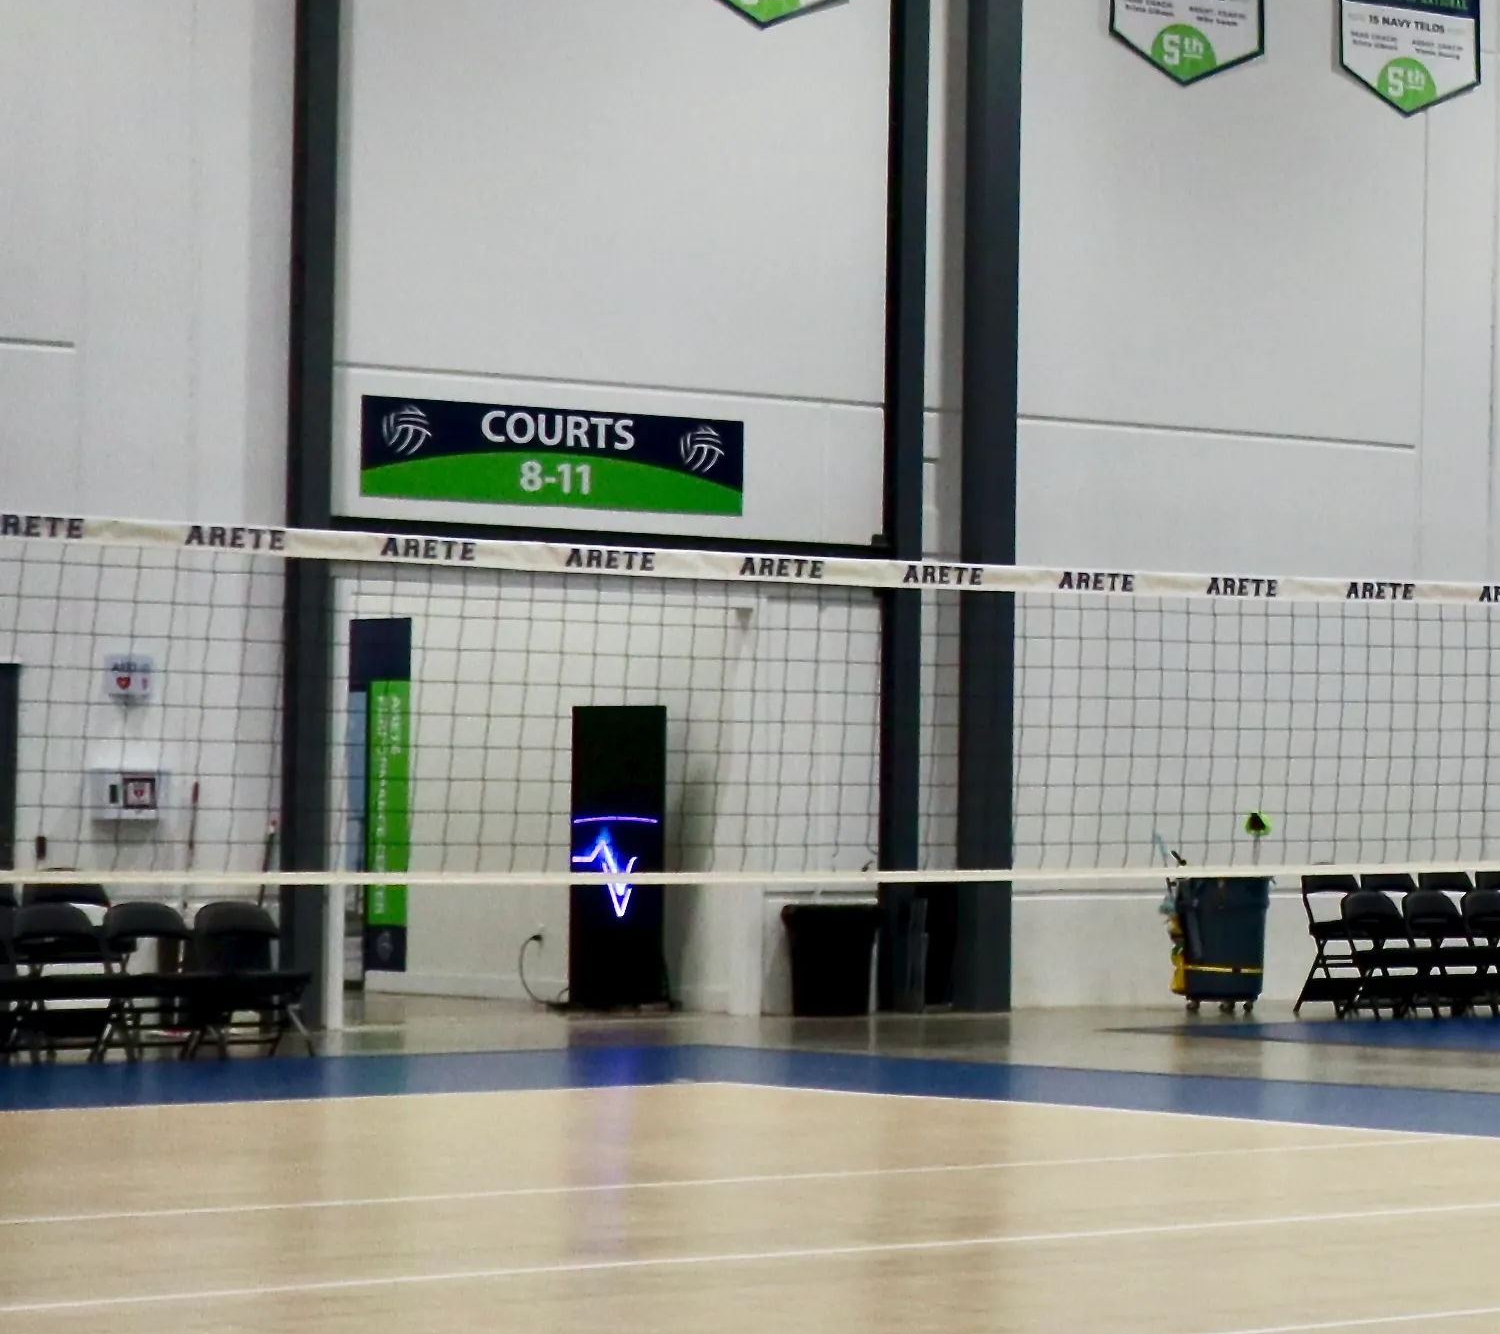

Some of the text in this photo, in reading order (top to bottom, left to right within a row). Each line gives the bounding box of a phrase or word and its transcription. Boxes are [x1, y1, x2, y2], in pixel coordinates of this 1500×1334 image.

[1368, 15, 1445, 34] 15 NAVY TELOS
[481, 410, 635, 450] COURTS
[519, 460, 592, 495] 8-11
[0, 514, 85, 539] RETE
[185, 525, 285, 551] ARETE
[381, 537, 476, 561] ARETE
[565, 548, 656, 571] ARETE
[739, 557, 825, 579] ARETE
[902, 565, 983, 586] ARETE
[1058, 571, 1135, 593] ARETE
[1206, 577, 1278, 597] ARETE
[1346, 581, 1416, 601] ARETE
